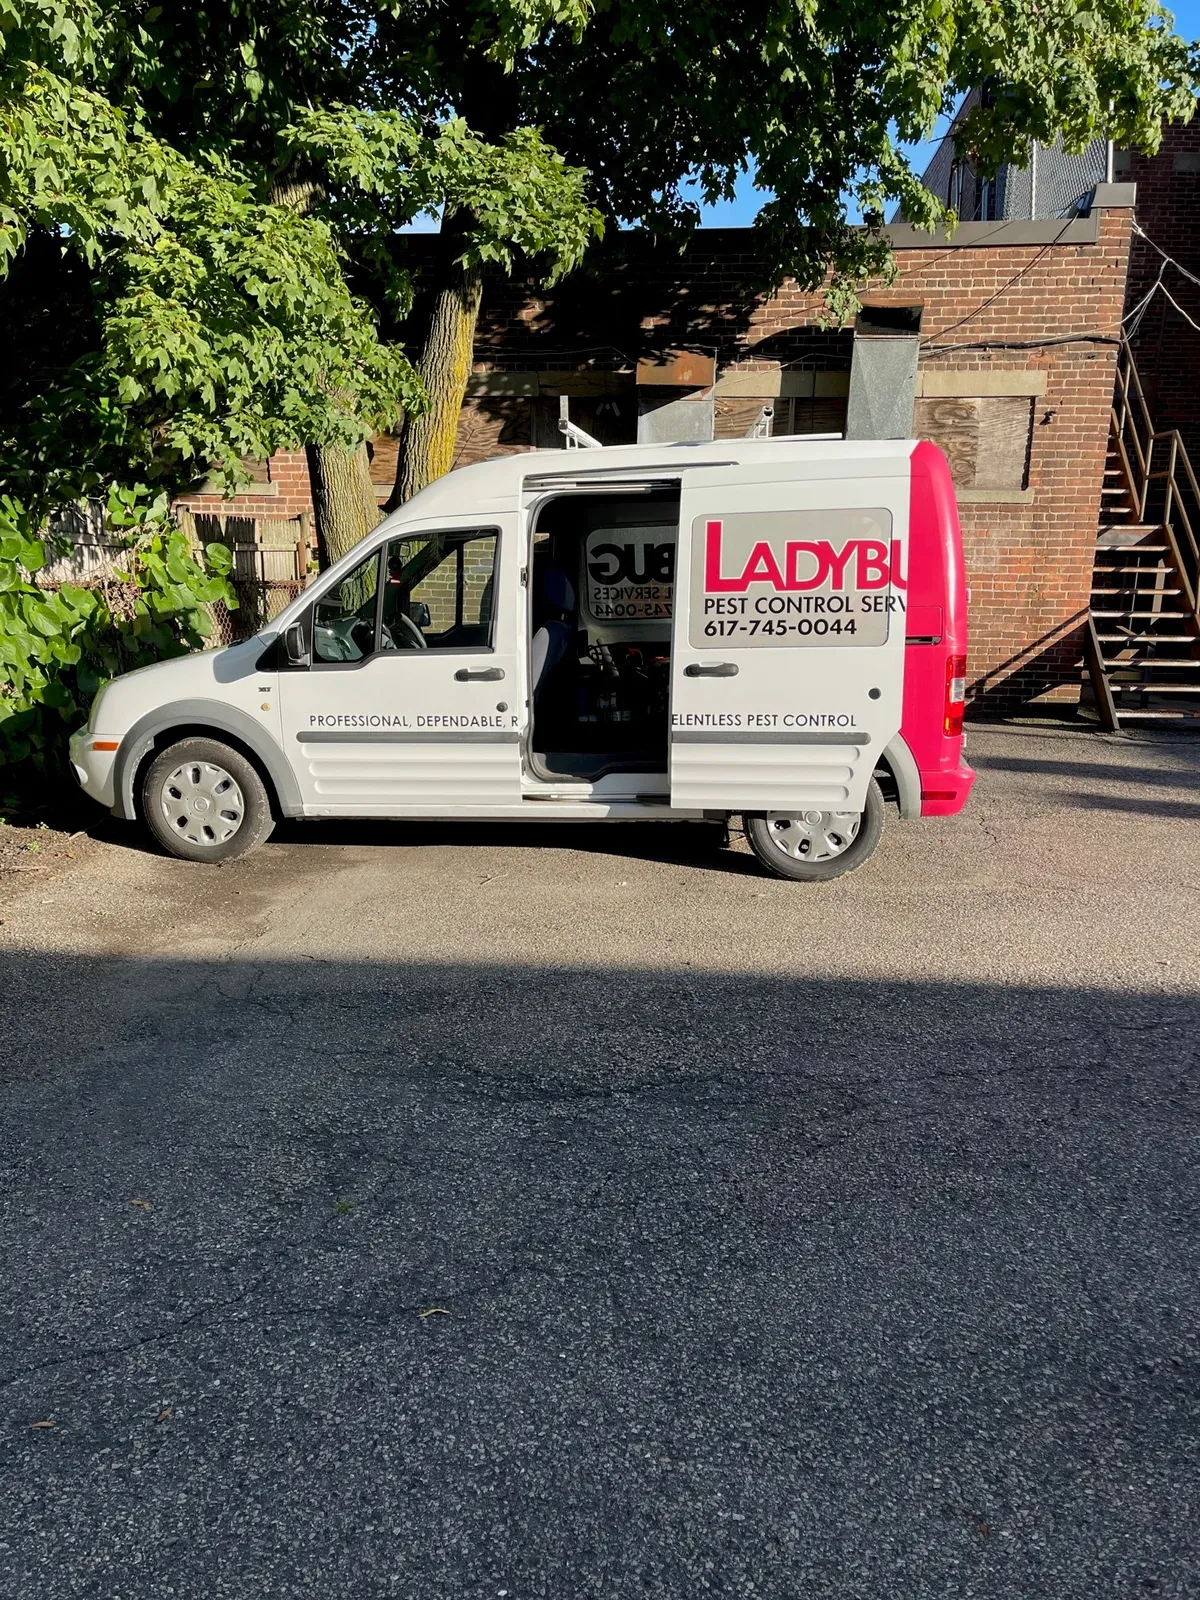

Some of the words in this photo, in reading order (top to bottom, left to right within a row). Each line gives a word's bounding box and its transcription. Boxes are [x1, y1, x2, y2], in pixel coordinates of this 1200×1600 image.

[704, 597, 748, 615] PEST
[755, 596, 854, 613] CONTROL
[704, 619, 857, 637] 617-745-0044
[309, 715, 412, 728] PROFESSIONAL,
[417, 715, 506, 728] DEPENDABLE,
[511, 715, 519, 727] R
[671, 714, 742, 726] ELENTLESS
[747, 714, 778, 727] PEST
[783, 714, 857, 727] CONTROL
